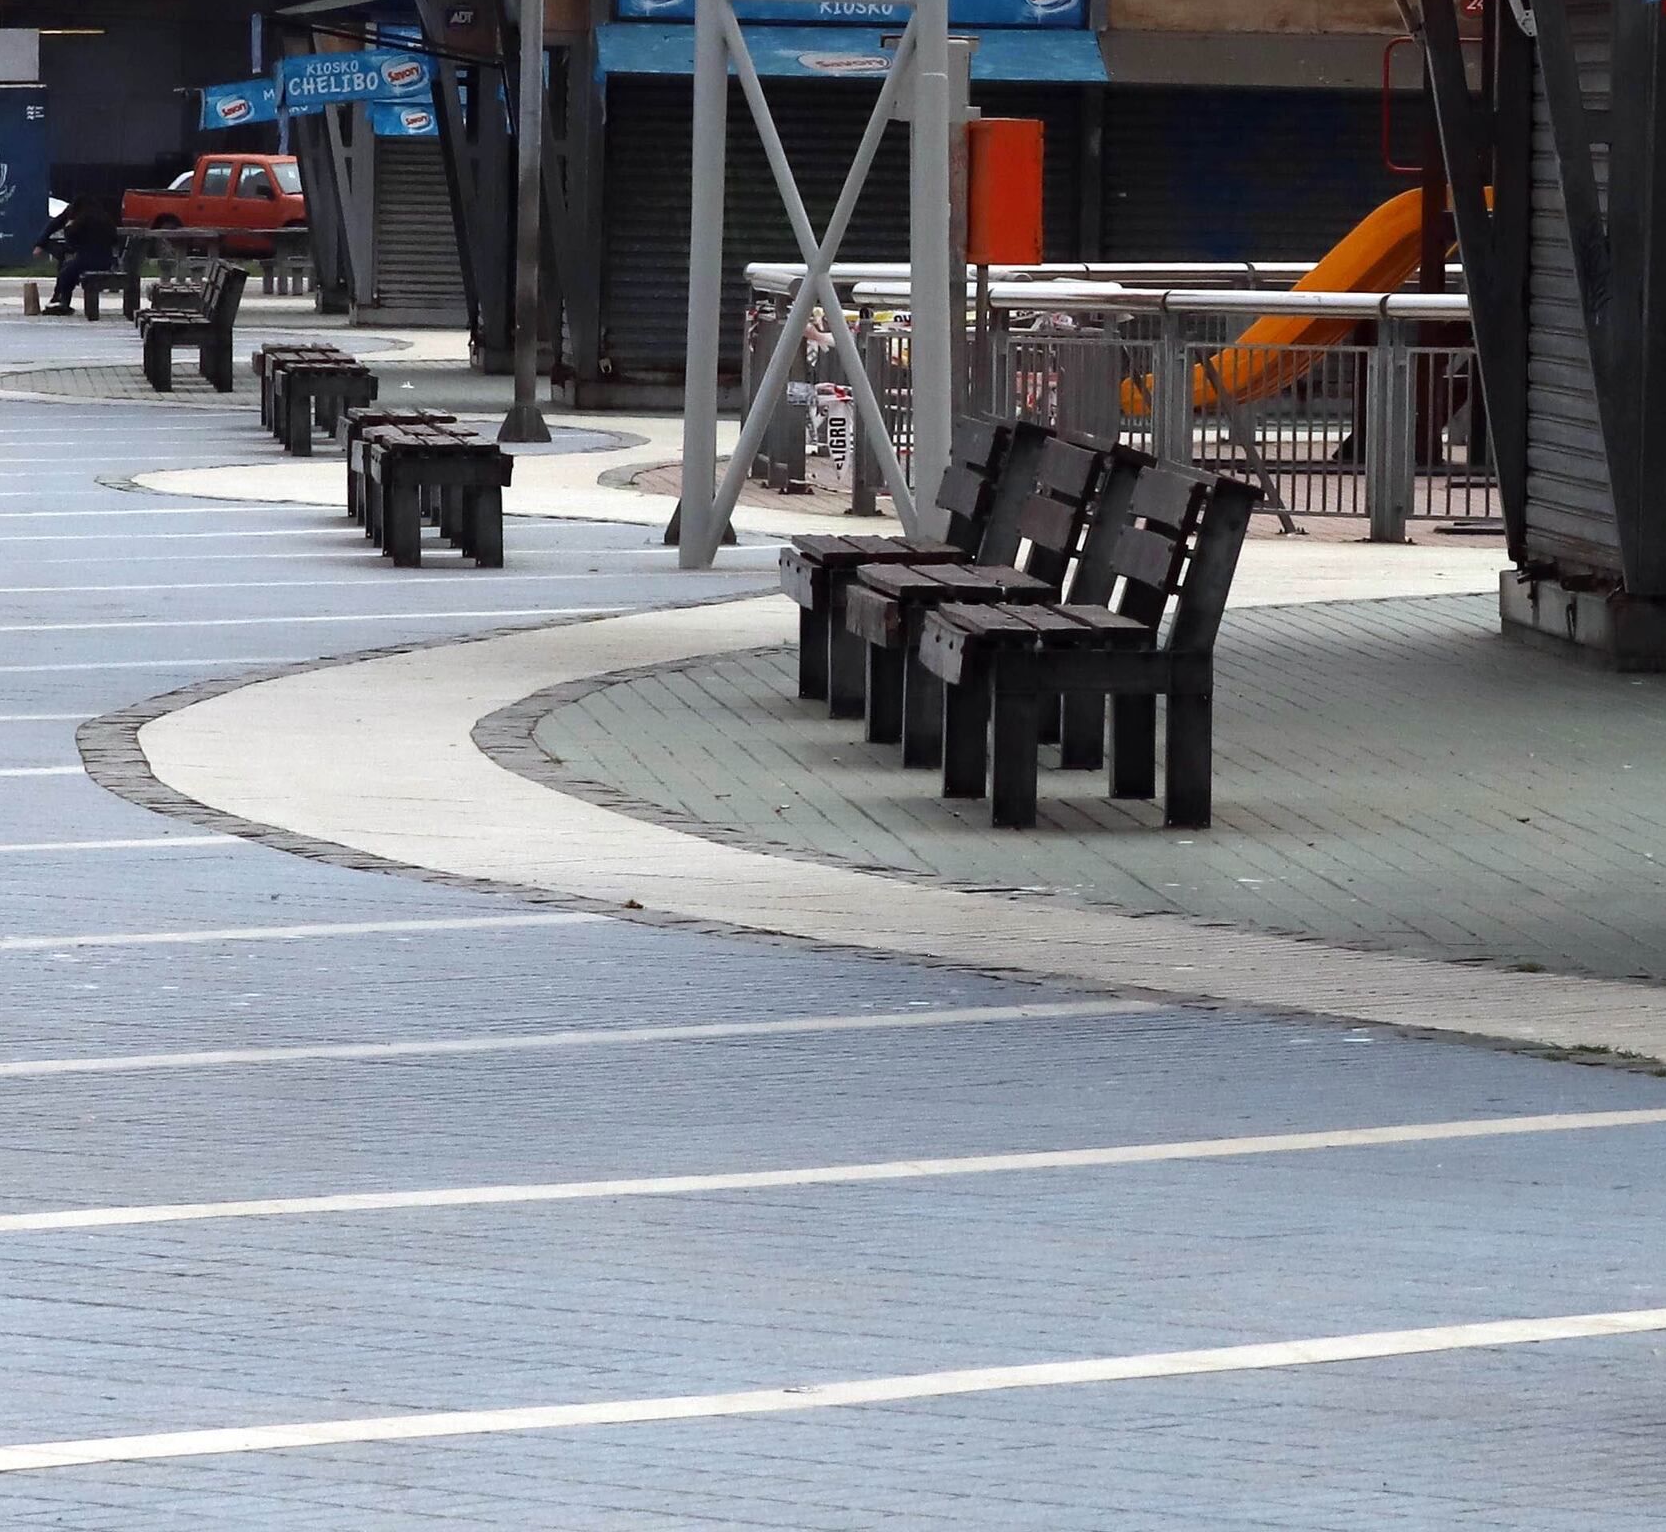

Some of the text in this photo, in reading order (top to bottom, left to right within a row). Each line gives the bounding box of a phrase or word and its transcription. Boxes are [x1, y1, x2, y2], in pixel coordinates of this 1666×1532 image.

[450, 11, 473, 23] ADT
[307, 60, 359, 74] KIOSKO
[387, 62, 420, 81] Savory
[288, 72, 379, 96] CHELIBO
[830, 417, 846, 471] LIGRO
